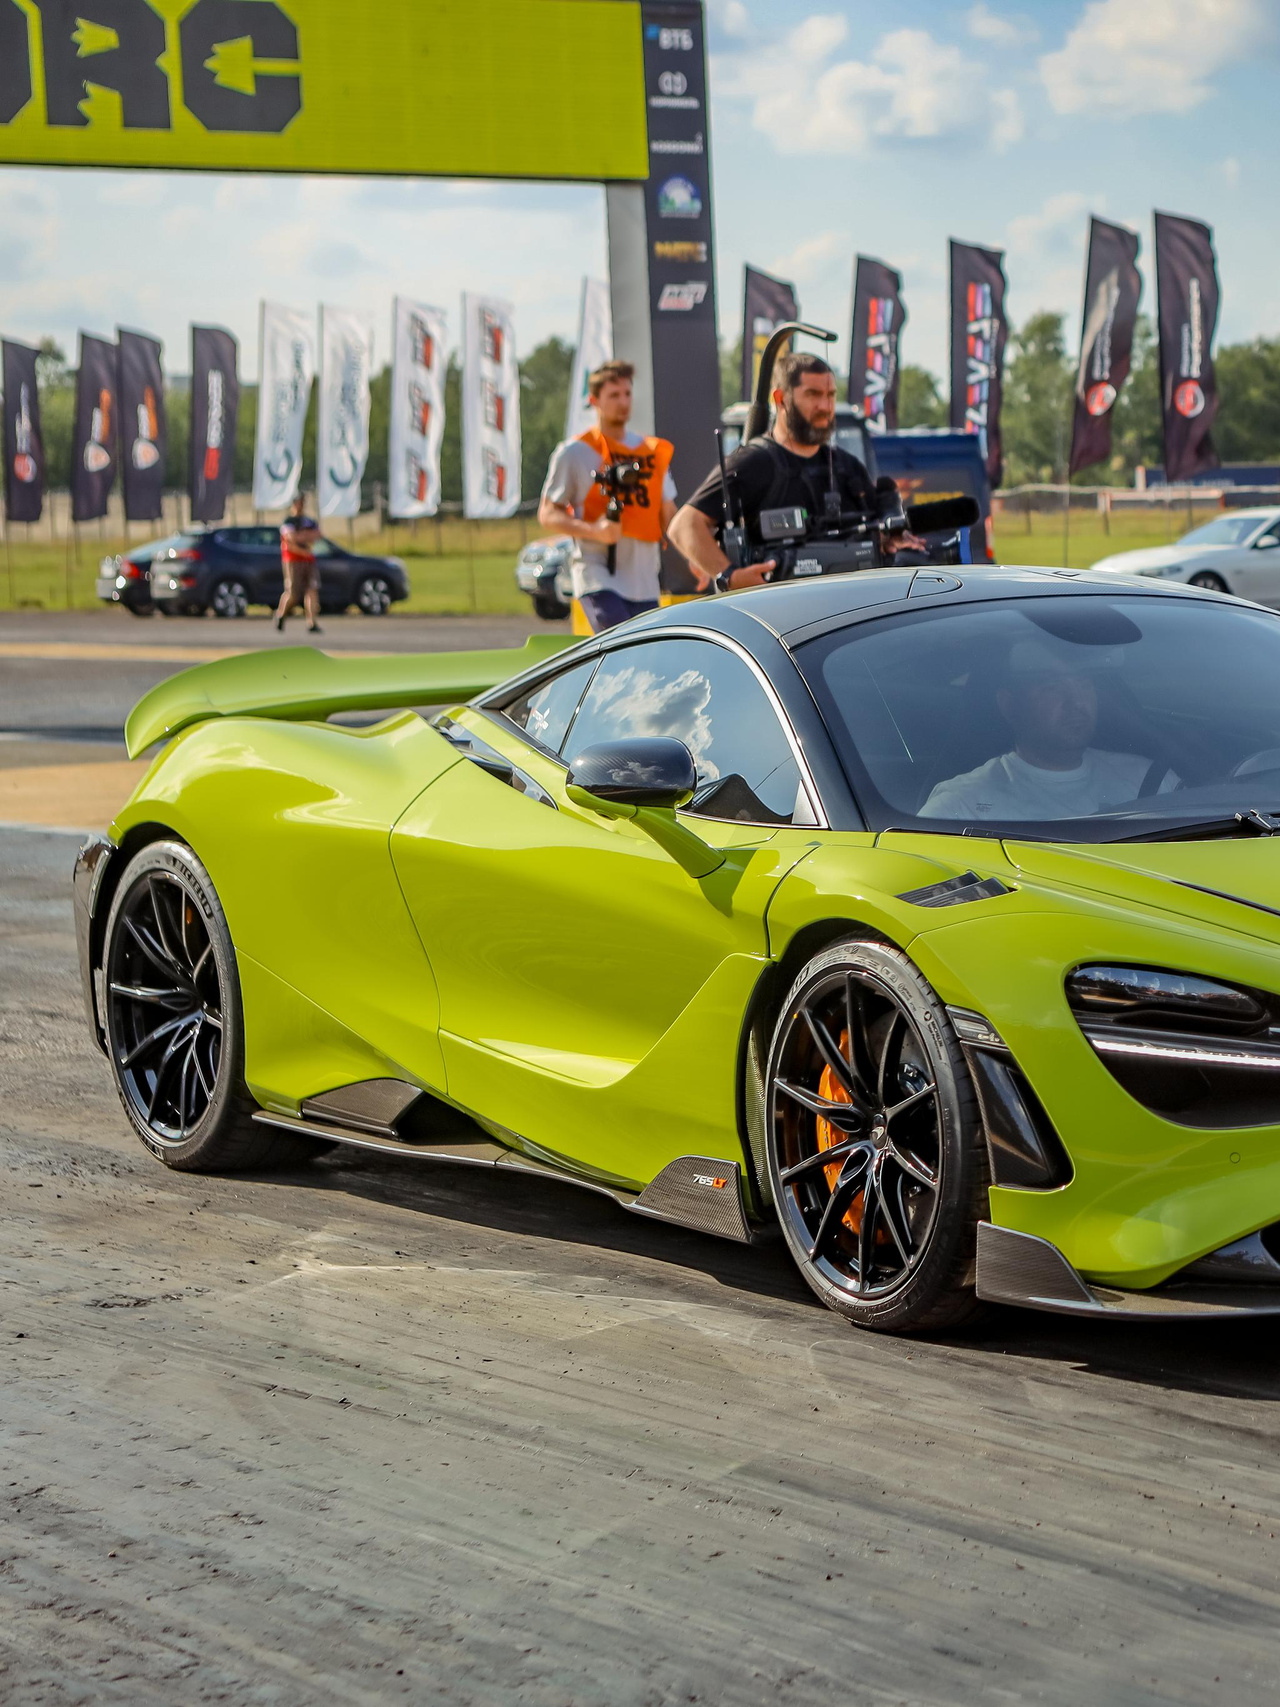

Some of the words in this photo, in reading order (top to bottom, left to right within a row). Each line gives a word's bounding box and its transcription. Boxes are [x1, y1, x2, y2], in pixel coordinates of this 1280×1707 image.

[0, 0, 302, 132] RC
[173, 857, 213, 919] MICHELIN
[931, 1020, 943, 1047] MICHELIN
[693, 1173, 727, 1189] 765LT
